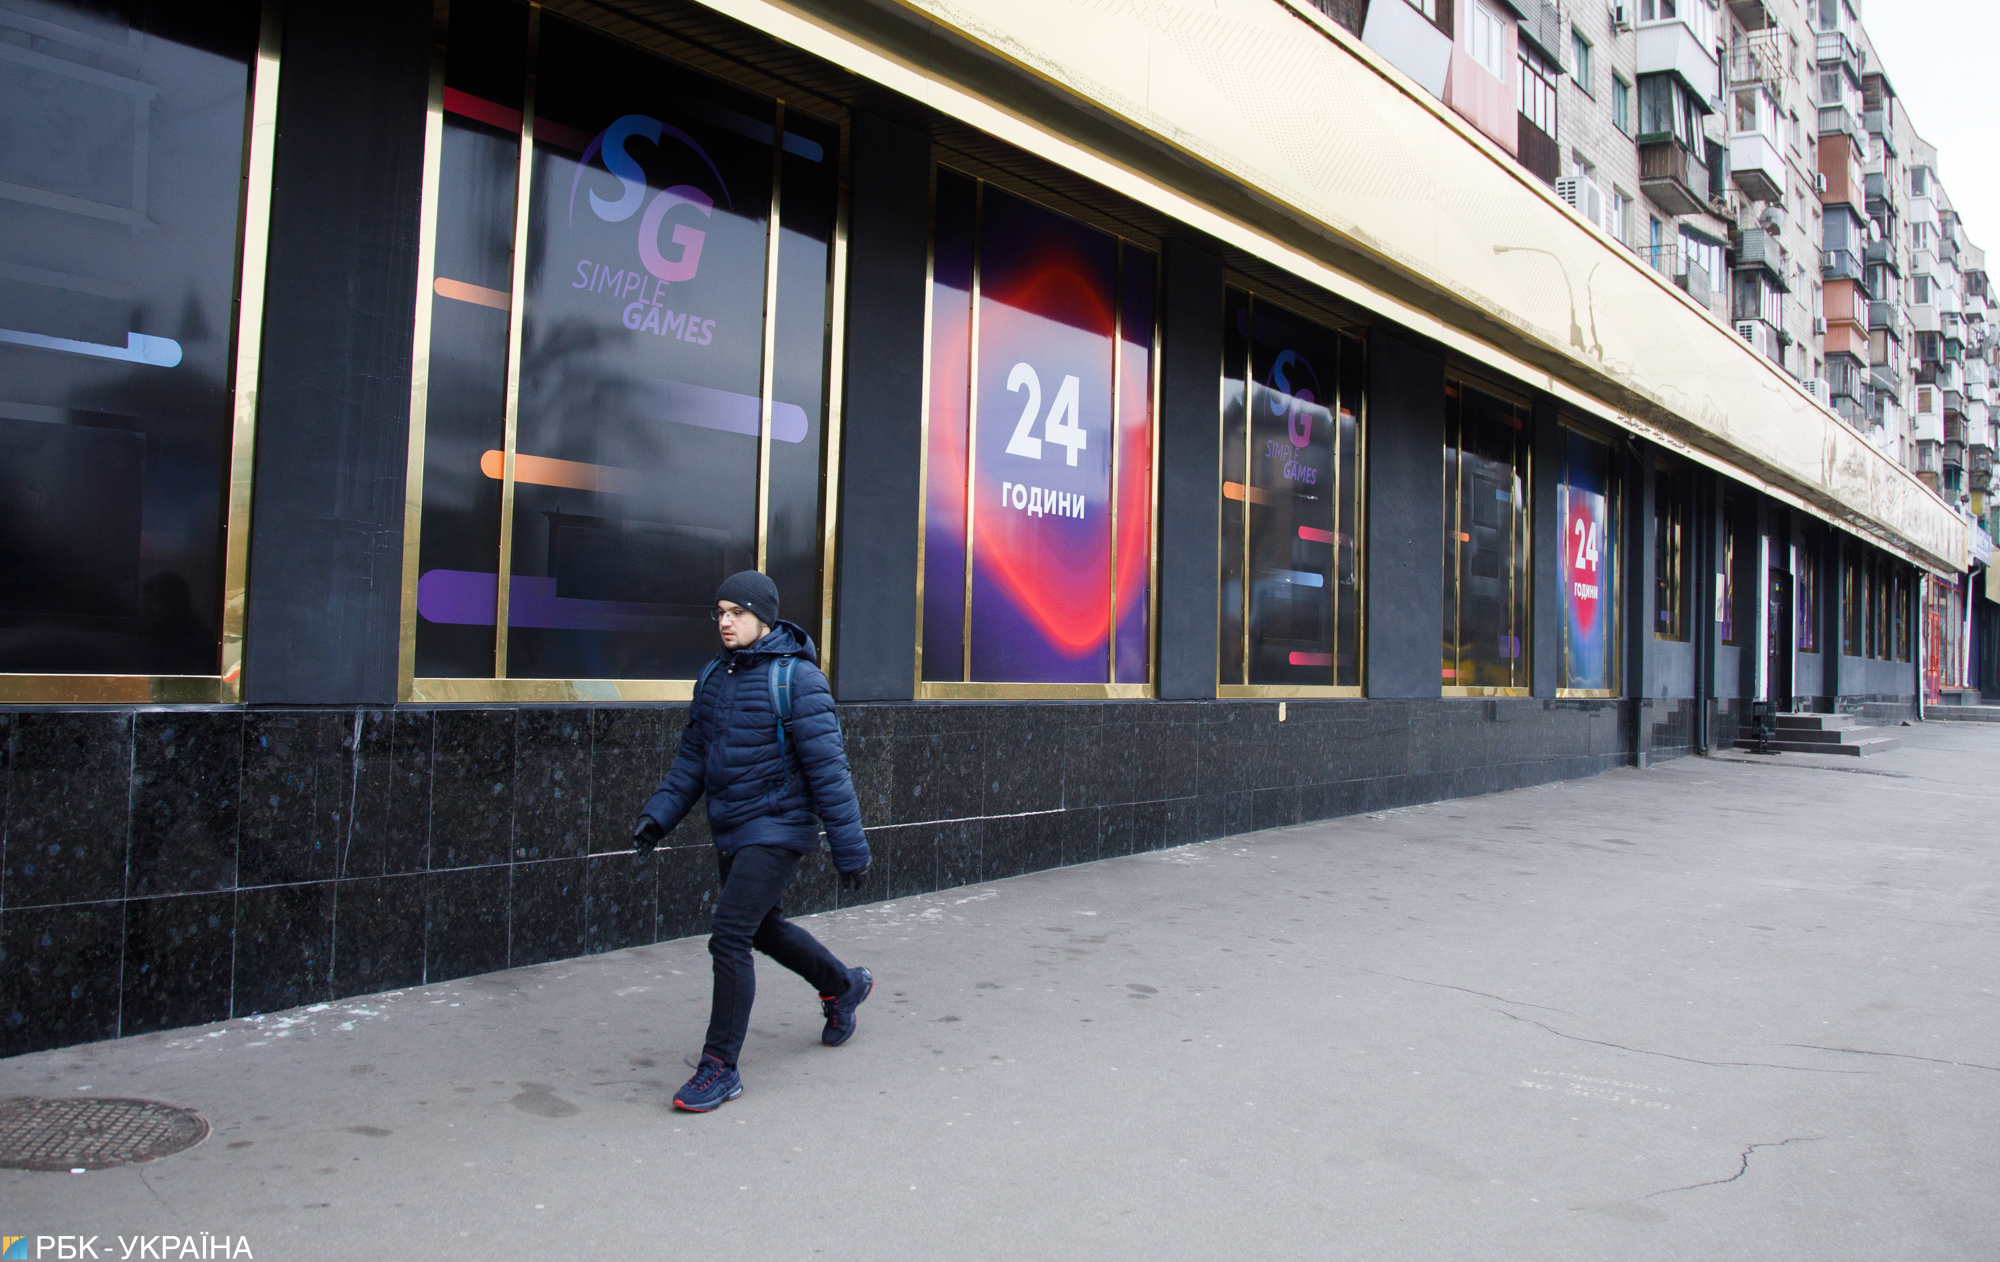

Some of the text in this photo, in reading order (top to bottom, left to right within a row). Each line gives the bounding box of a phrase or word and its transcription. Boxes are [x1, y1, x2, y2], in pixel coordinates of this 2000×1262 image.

[589, 114, 714, 282] SG
[572, 259, 670, 308] SIMPLE
[622, 301, 716, 346] GAMES
[1005, 362, 1087, 467] 24
[1265, 439, 1300, 464] SIMPLE
[1283, 462, 1318, 485] GAMES
[1575, 518, 1599, 572] 24
